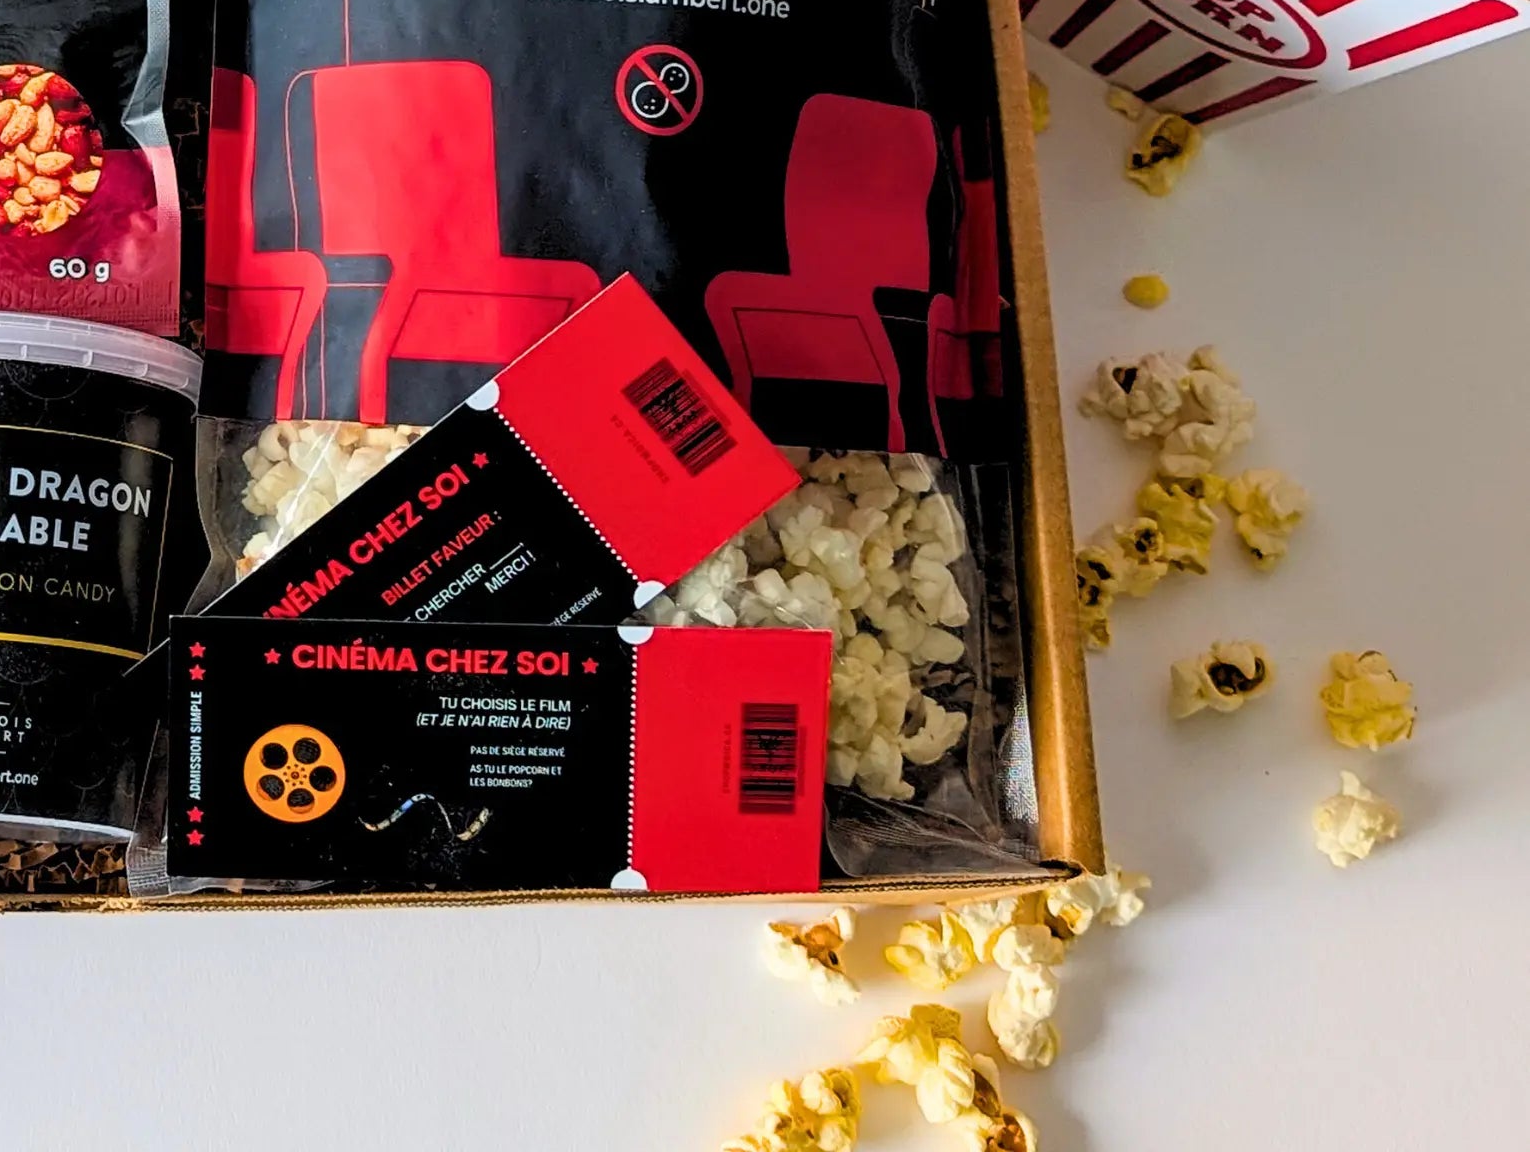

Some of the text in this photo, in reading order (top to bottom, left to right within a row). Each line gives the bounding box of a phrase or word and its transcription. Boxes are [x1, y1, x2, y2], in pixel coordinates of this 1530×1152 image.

[49, 258, 111, 283] 60 g
[9, 466, 151, 518] DRAGON
[263, 463, 471, 619] NÉMA CHEZ SOI
[380, 513, 496, 606] BILLET FAVEUR
[484, 554, 530, 594] MERCI
[44, 577, 116, 603] CANDY
[414, 563, 487, 622] CHERCHER
[291, 638, 570, 676] CINÉMA CHEZ SOI
[439, 696, 571, 712] TU CHOISIS LE FILM
[440, 714, 456, 727] JE
[487, 715, 520, 728] RIEN
[522, 713, 532, 728] À
[535, 716, 571, 731] DIRE)
[189, 690, 203, 801] ADMISSION SIMPLE
[470, 745, 488, 755] PAS
[489, 746, 501, 756] DE
[469, 777, 486, 787] LES
[496, 765, 507, 774] LE
[508, 765, 550, 775] POPCORN
[551, 766, 562, 776] ET
